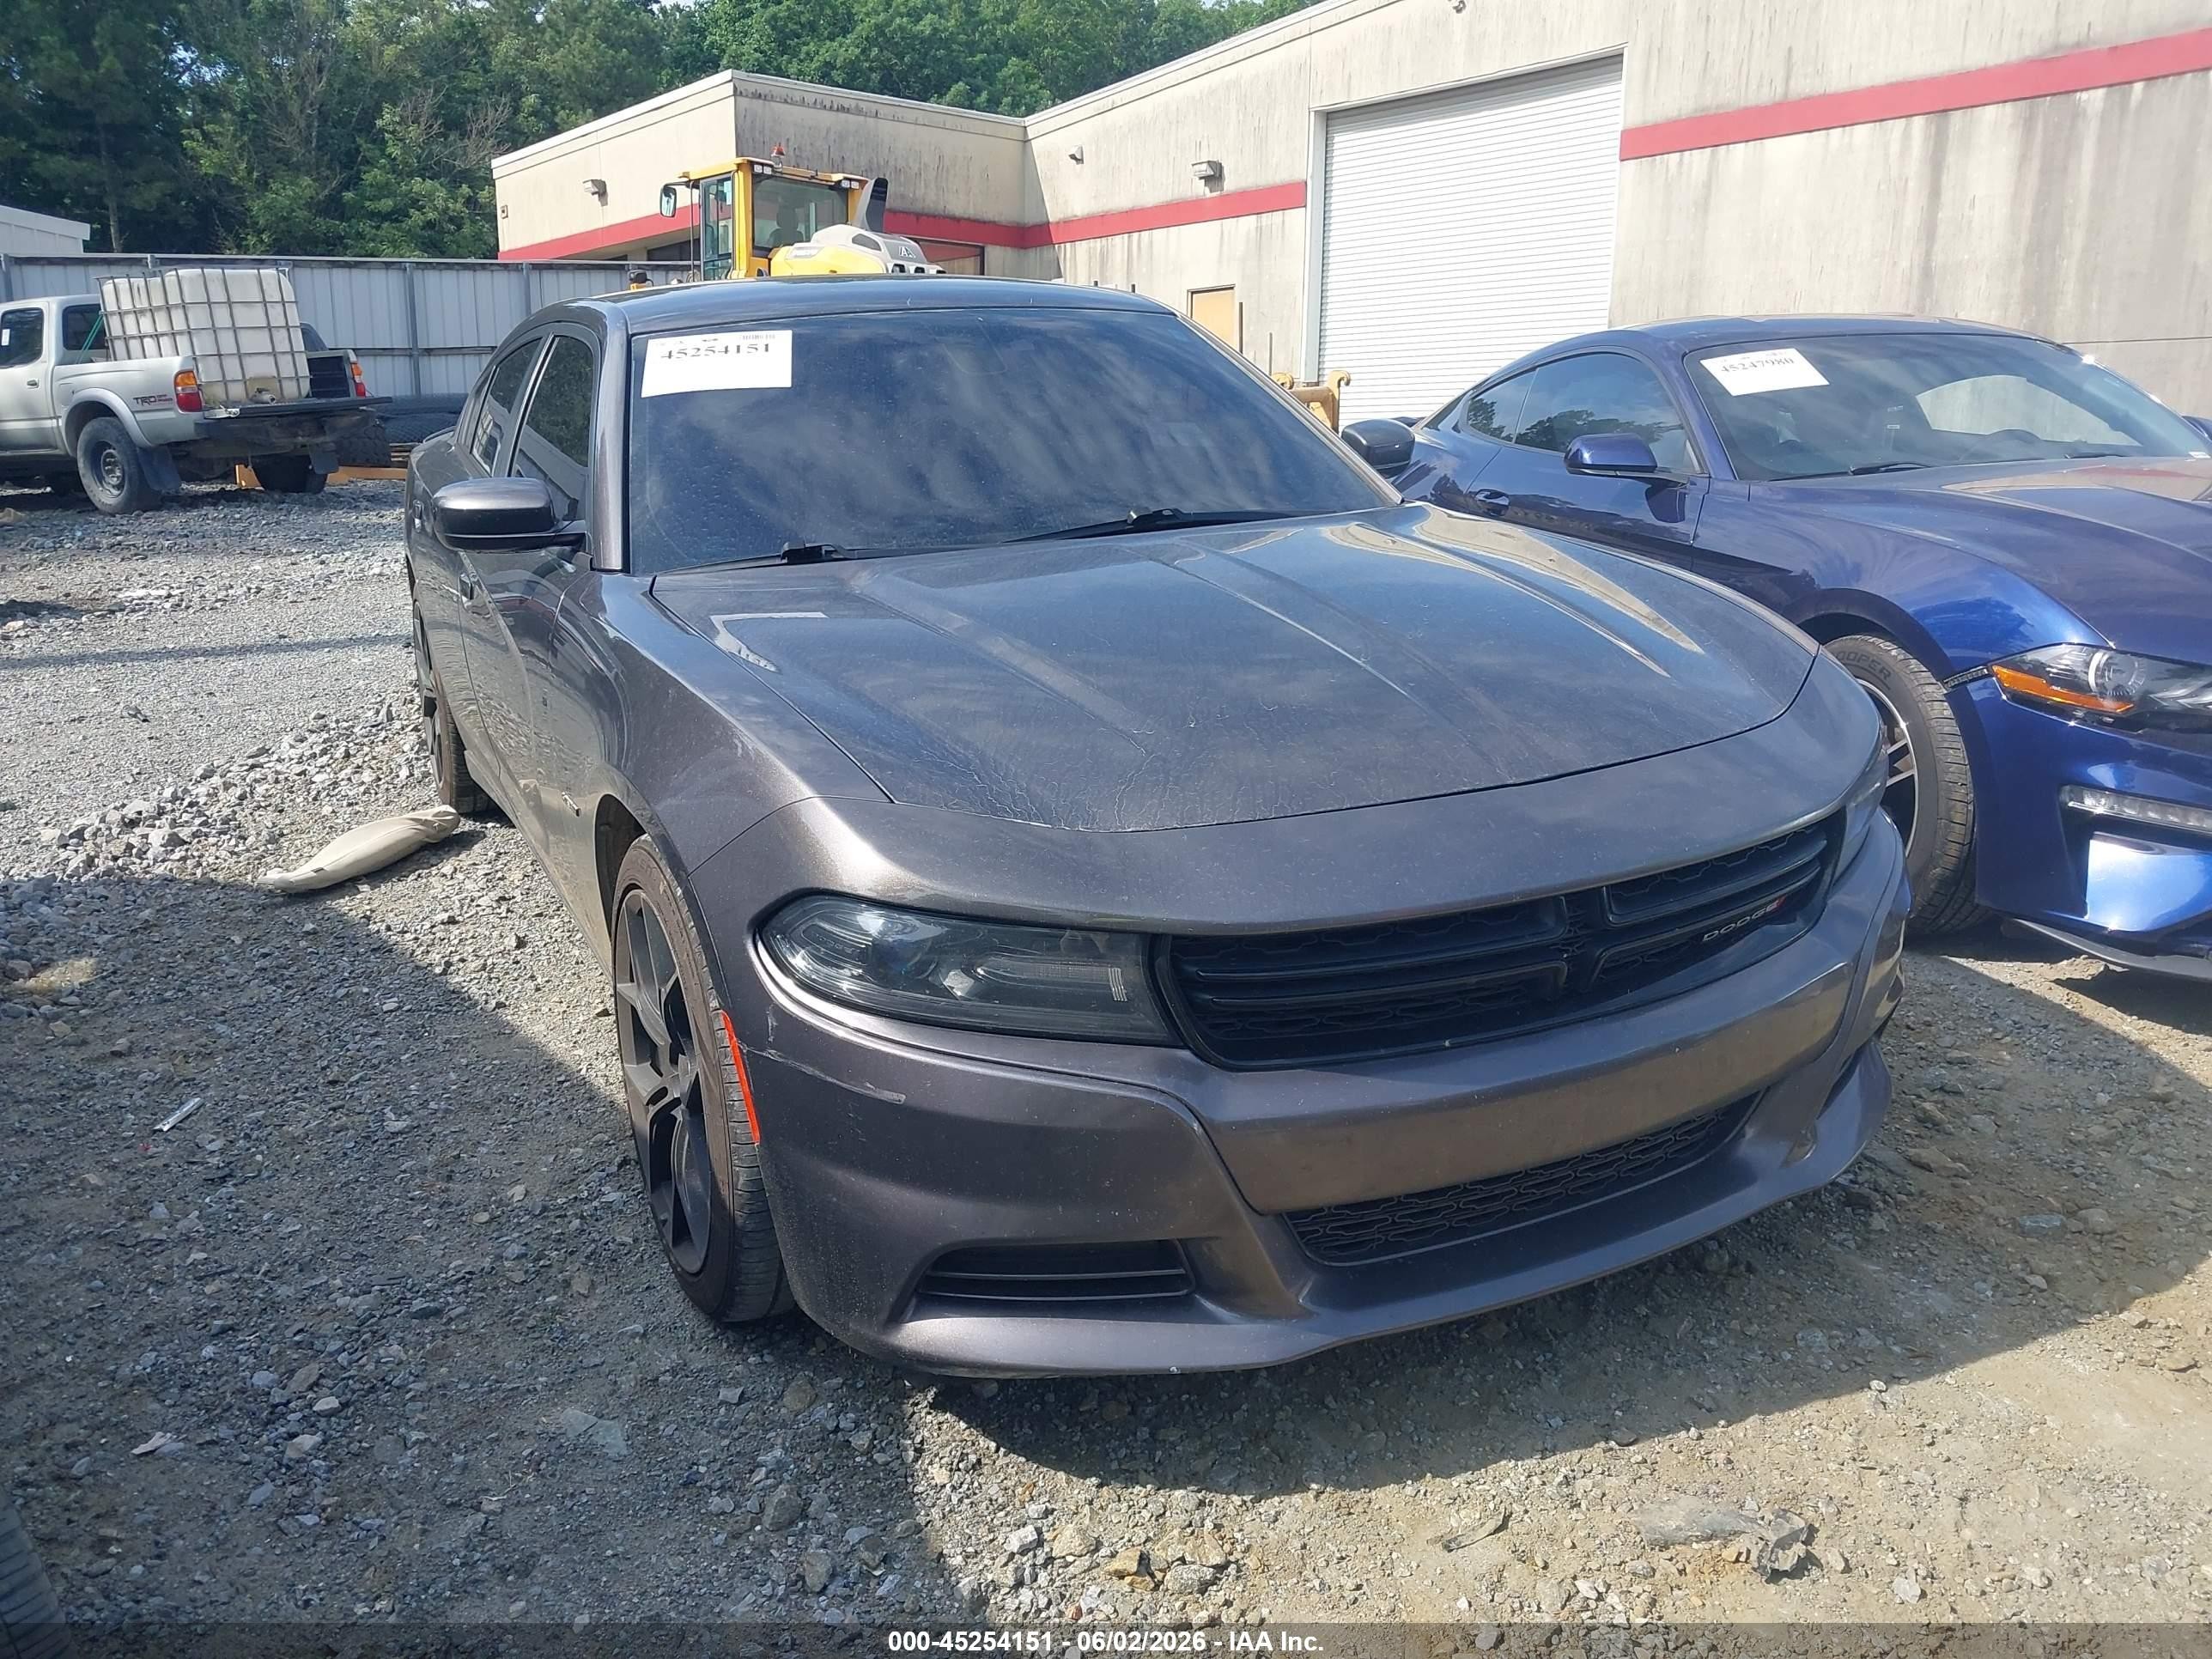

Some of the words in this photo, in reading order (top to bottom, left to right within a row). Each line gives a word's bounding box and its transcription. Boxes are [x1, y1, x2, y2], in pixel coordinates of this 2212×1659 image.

[660, 343, 769, 359] 45254151
[1836, 651, 1892, 681] OOPER
[1703, 900, 1779, 941] DODGE
